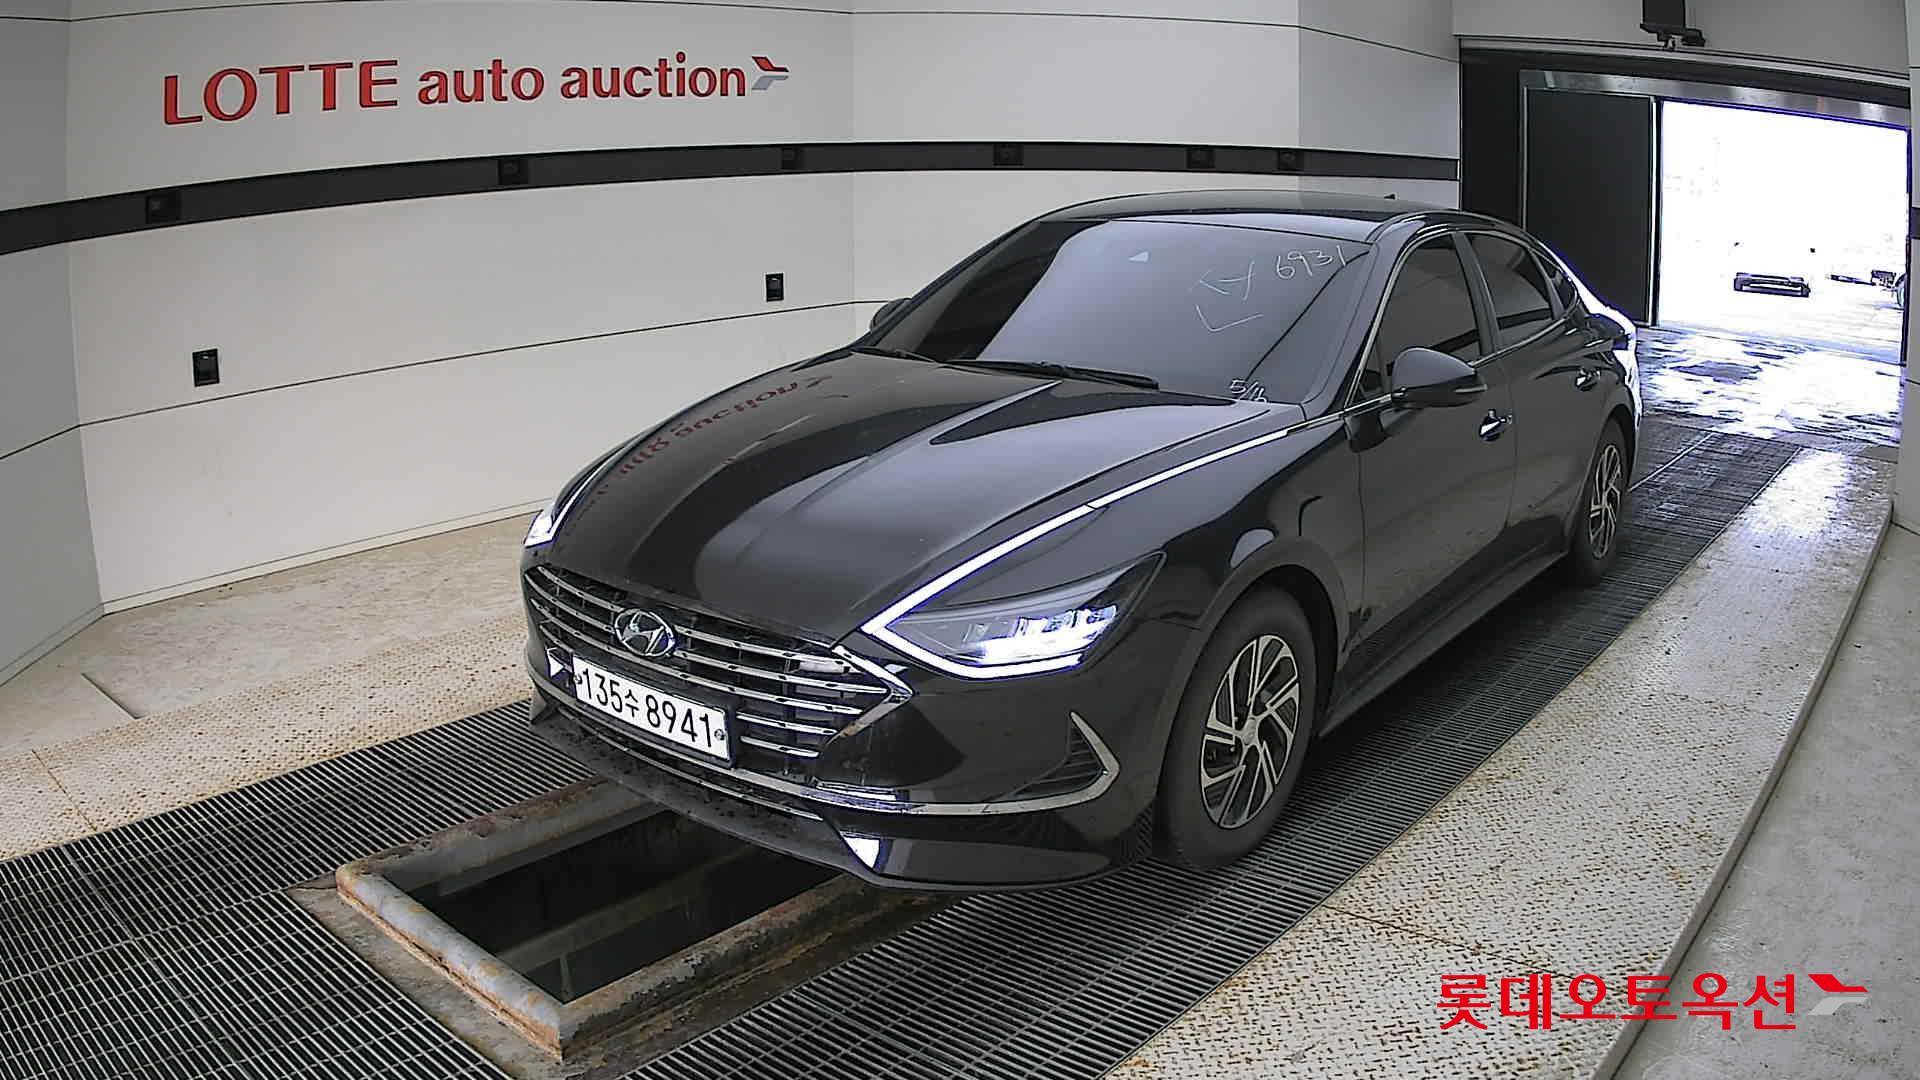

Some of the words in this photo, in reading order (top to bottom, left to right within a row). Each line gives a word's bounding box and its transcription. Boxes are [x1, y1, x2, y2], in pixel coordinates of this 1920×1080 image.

[162, 59, 400, 125] LOTTE
[417, 58, 546, 105] auto
[560, 51, 748, 99] auction
[1276, 244, 1347, 280] 6931
[582, 667, 640, 718] 135수
[645, 694, 713, 748] 8941
